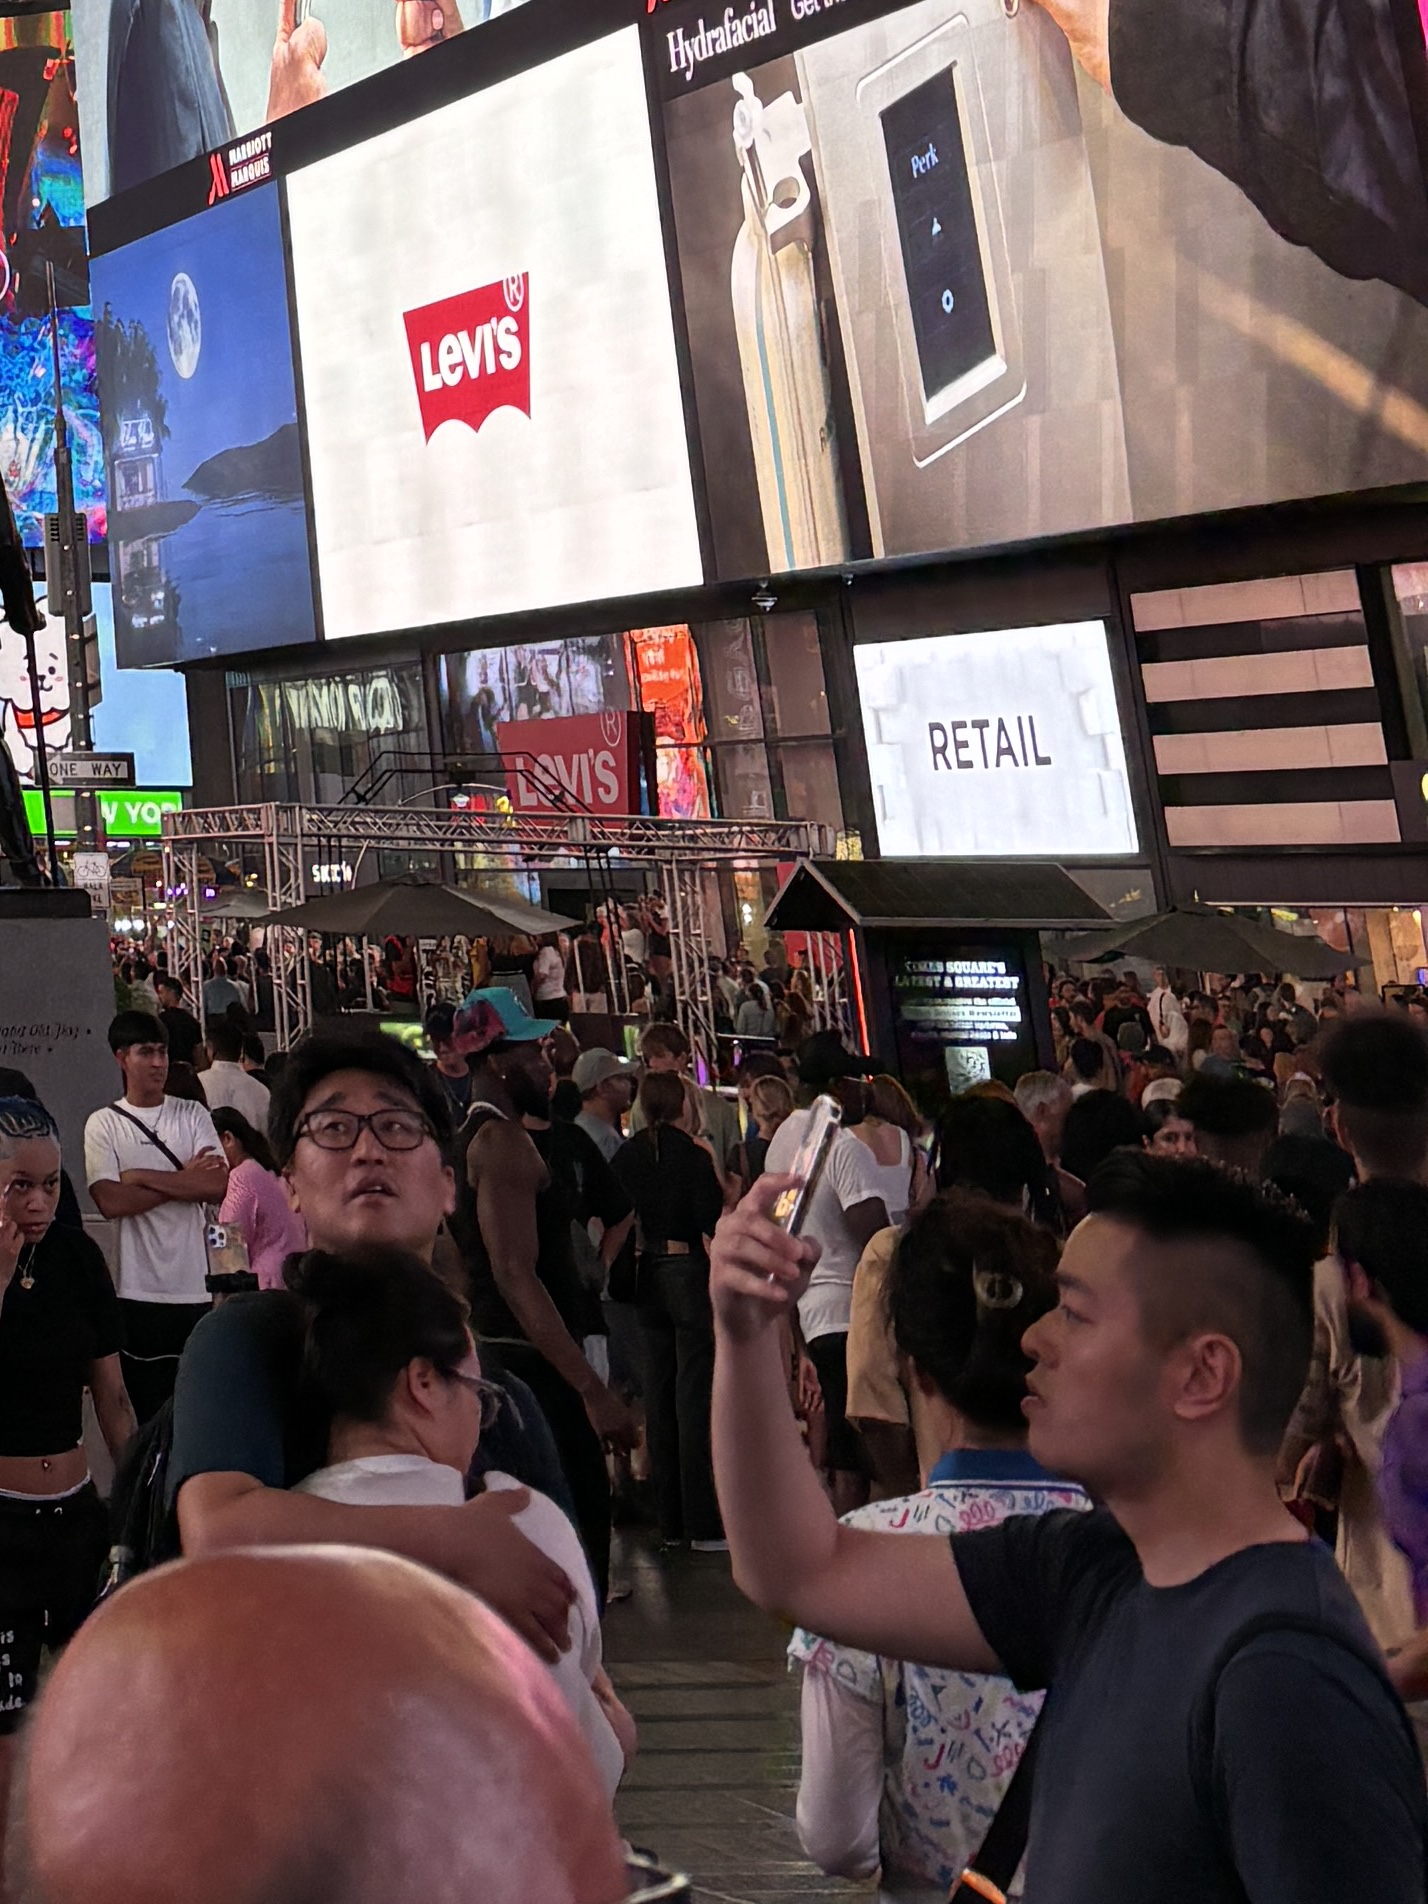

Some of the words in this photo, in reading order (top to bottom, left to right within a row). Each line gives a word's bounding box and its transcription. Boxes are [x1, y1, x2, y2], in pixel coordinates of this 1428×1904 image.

[228, 131, 273, 166] MARRIOTT
[910, 143, 939, 179] Perk
[231, 156, 270, 188] MARQUIS
[928, 712, 1053, 773] RETAIL
[49, 762, 79, 777] ONE
[90, 763, 122, 777] WAY
[0, 1630, 15, 1645] is
